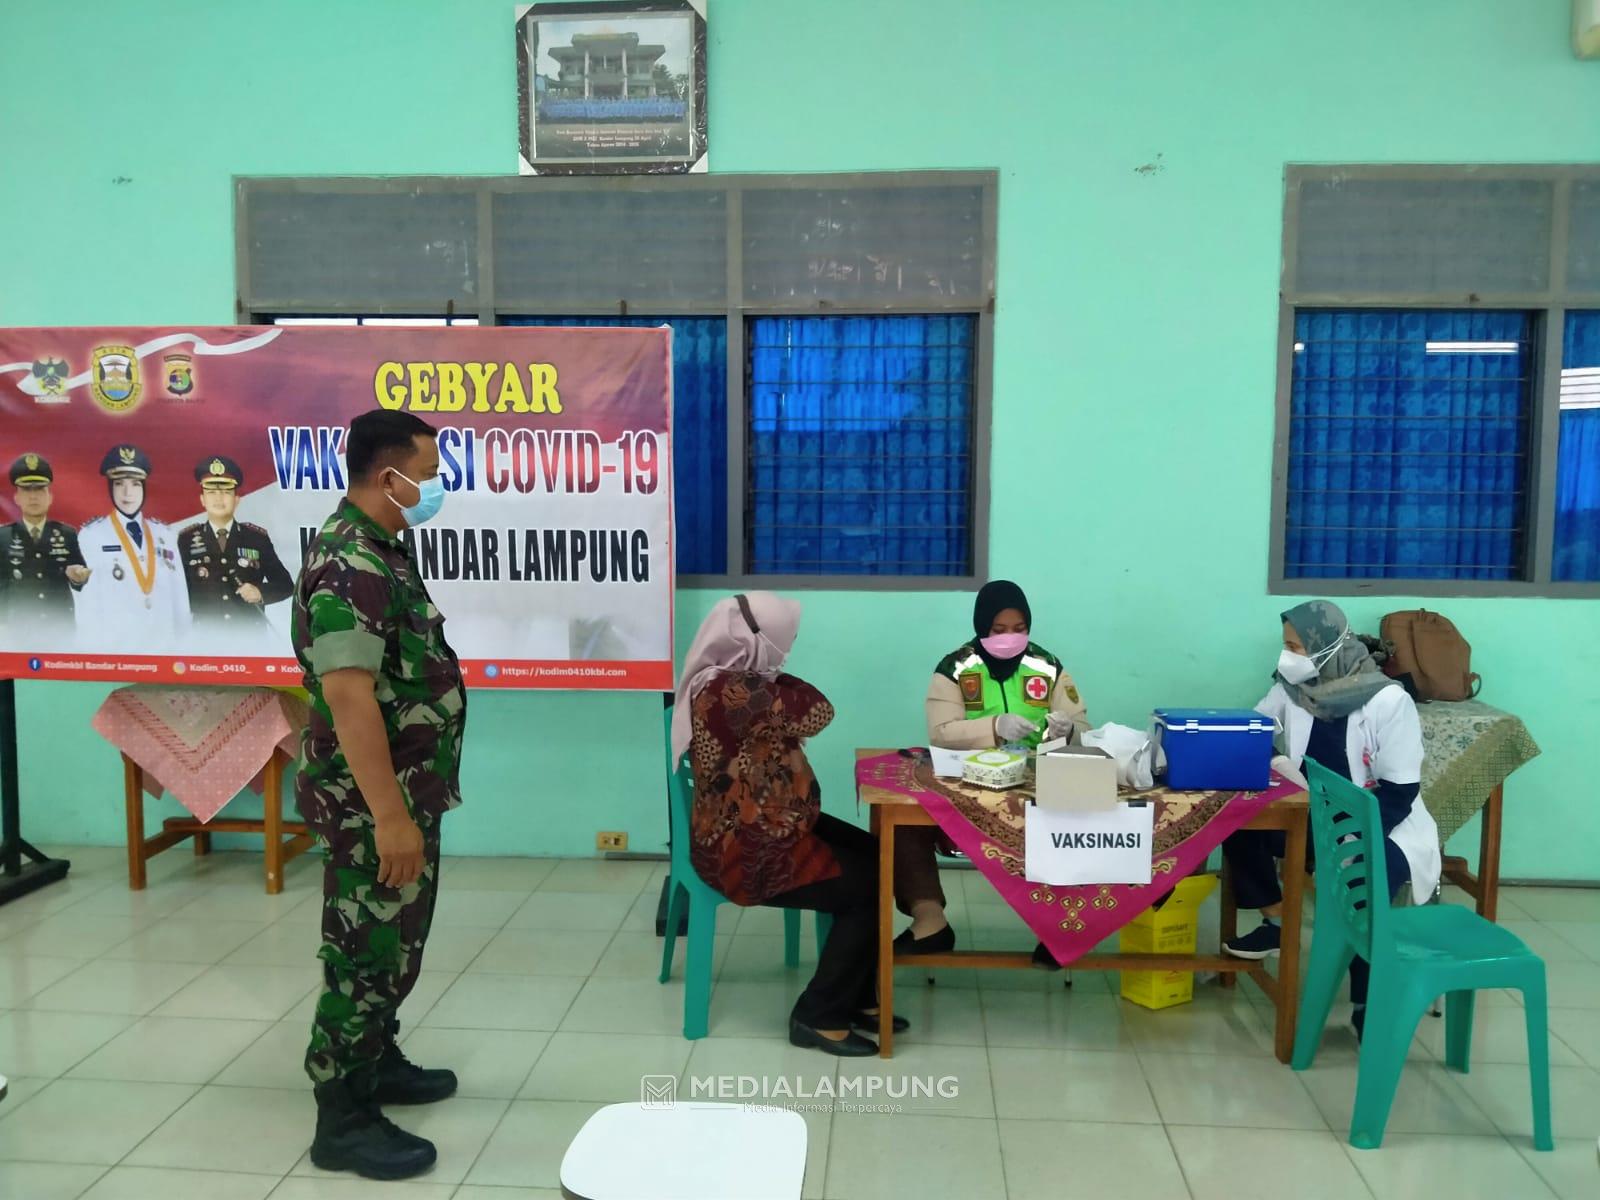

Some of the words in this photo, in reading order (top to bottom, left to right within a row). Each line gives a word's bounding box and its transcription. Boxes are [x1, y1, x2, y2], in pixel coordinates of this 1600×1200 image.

[375, 362, 563, 414] GEBYAR
[268, 427, 476, 491] VAKSI
[484, 428, 659, 495] COVID-19
[507, 529, 650, 583] LAMPUNG
[85, 662, 116, 671] Bandar
[117, 663, 158, 673] Lampung
[502, 667, 627, 677] https://kodim0410kbl.com
[1051, 832, 1141, 848] VAKSINASI
